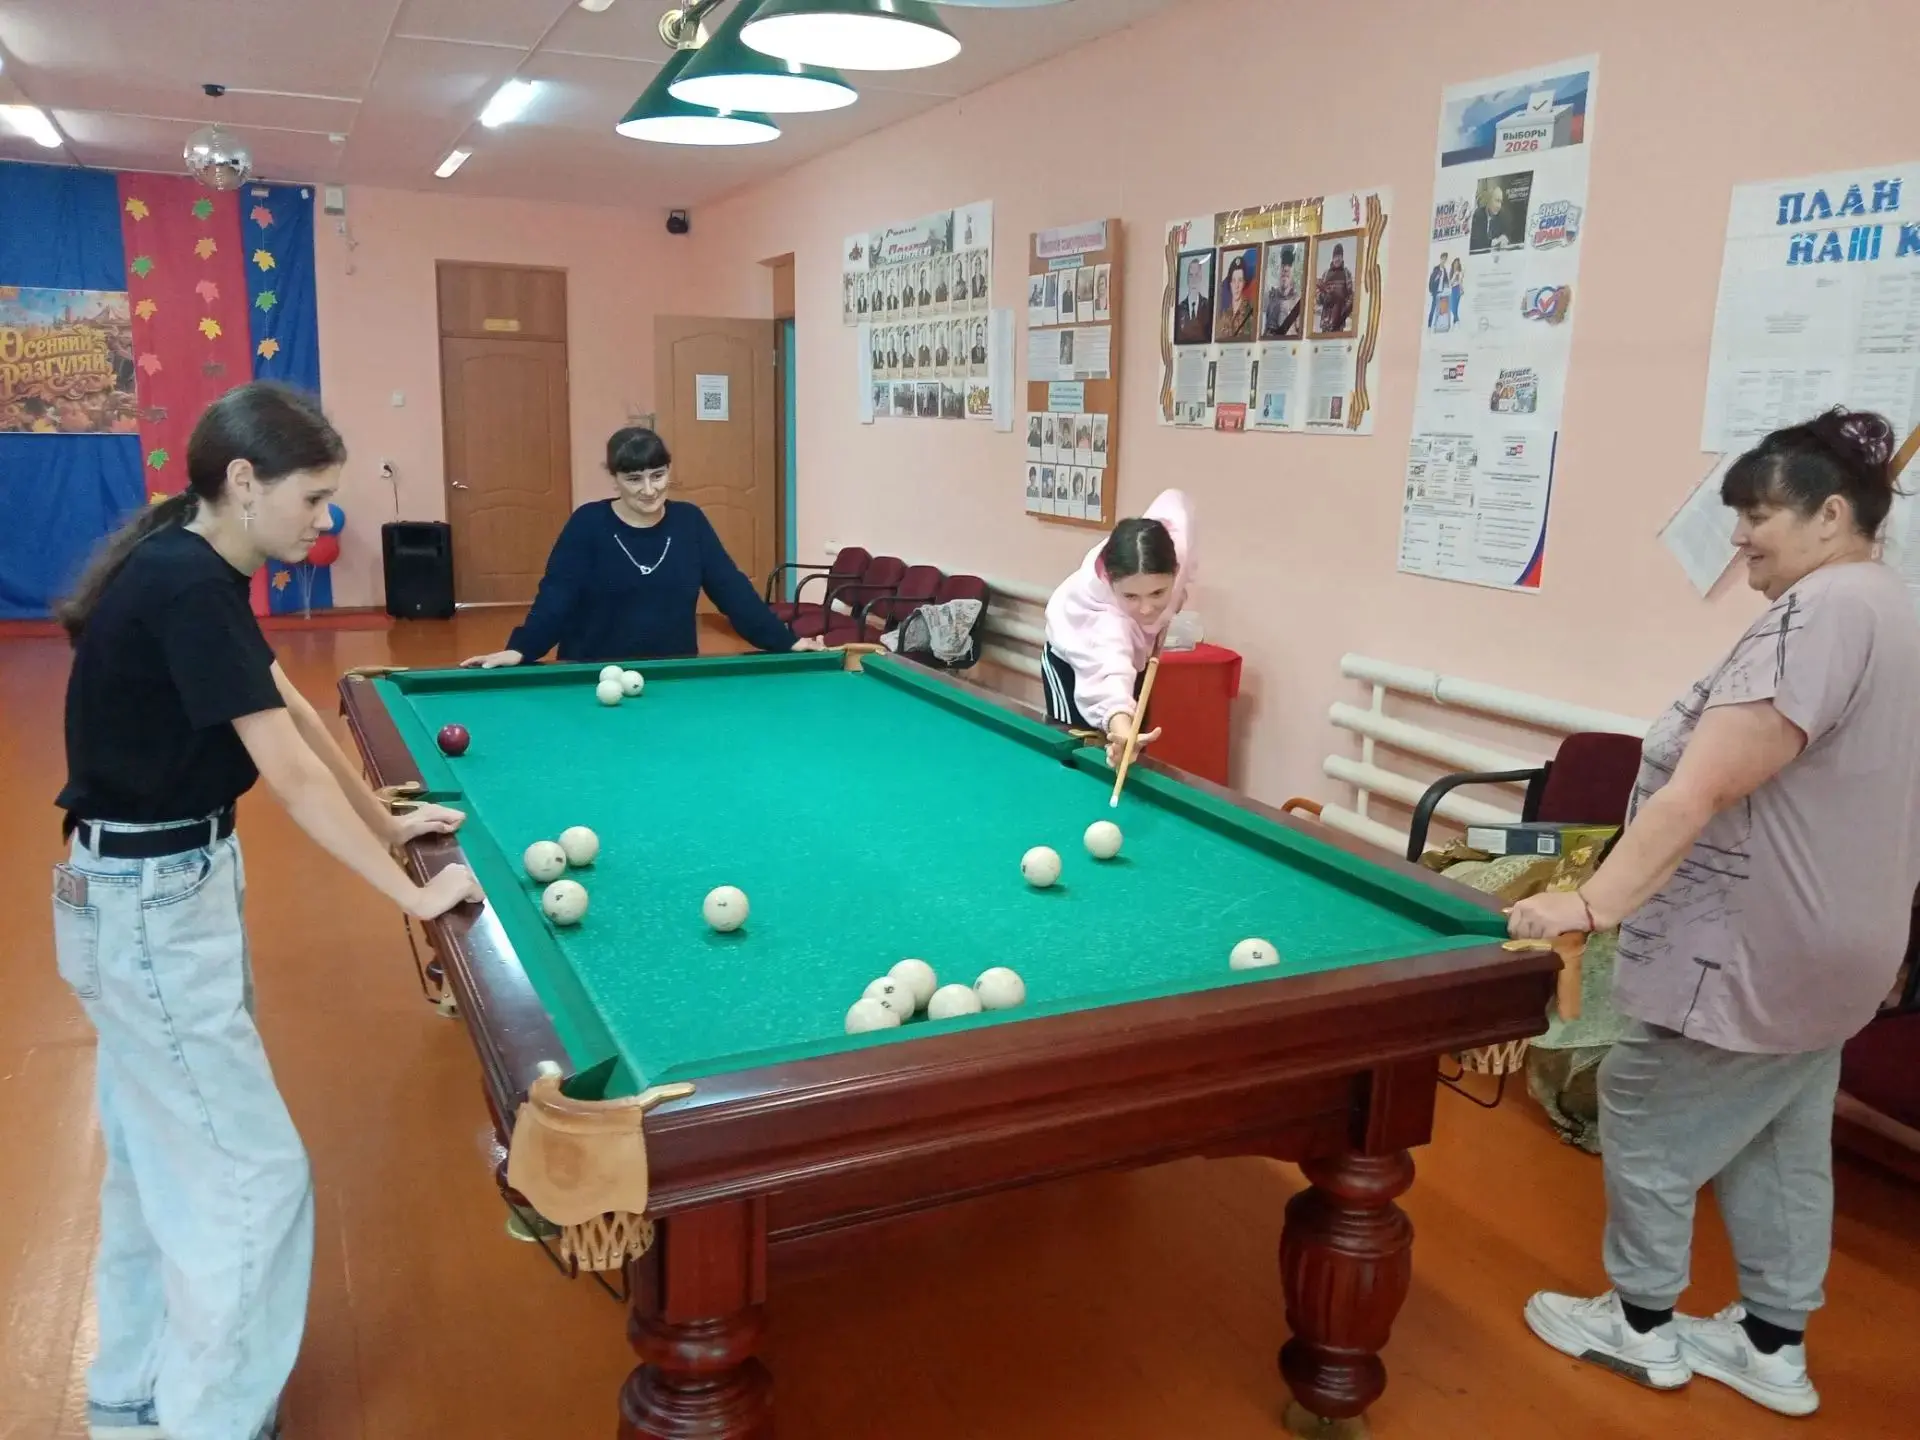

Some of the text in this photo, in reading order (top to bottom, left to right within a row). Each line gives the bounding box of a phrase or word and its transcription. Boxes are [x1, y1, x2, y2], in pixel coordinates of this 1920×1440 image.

[1502, 129, 1547, 141] ВЫБОРЫ
[1504, 140, 1539, 153] 2026
[1436, 201, 1455, 217] МОЙ
[1776, 178, 1903, 225] ПЛАН
[1786, 225, 1883, 266] НАШ
